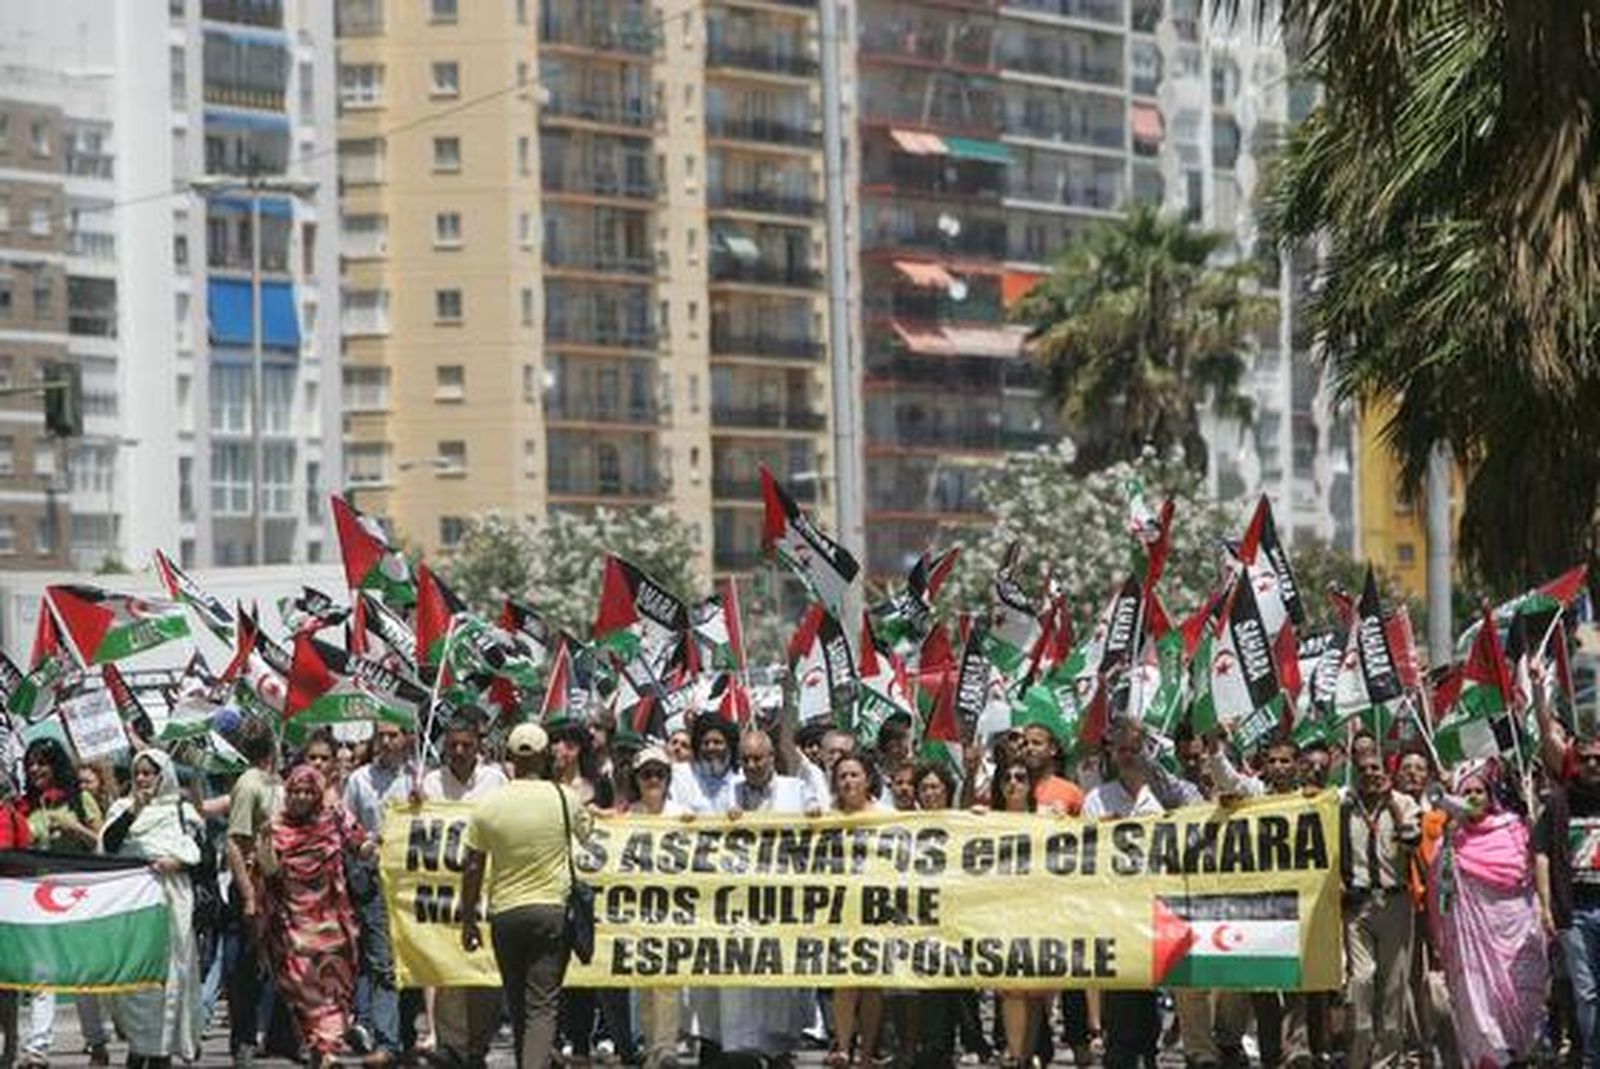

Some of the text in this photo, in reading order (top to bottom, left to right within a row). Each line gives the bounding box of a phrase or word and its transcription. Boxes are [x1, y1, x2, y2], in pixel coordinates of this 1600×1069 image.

[617, 826, 949, 876] ASESINATOS
[961, 833, 1032, 876] en
[1044, 823, 1097, 875] el
[1110, 812, 1329, 876] SAHARA
[794, 936, 1117, 979] RESPONSABLE
